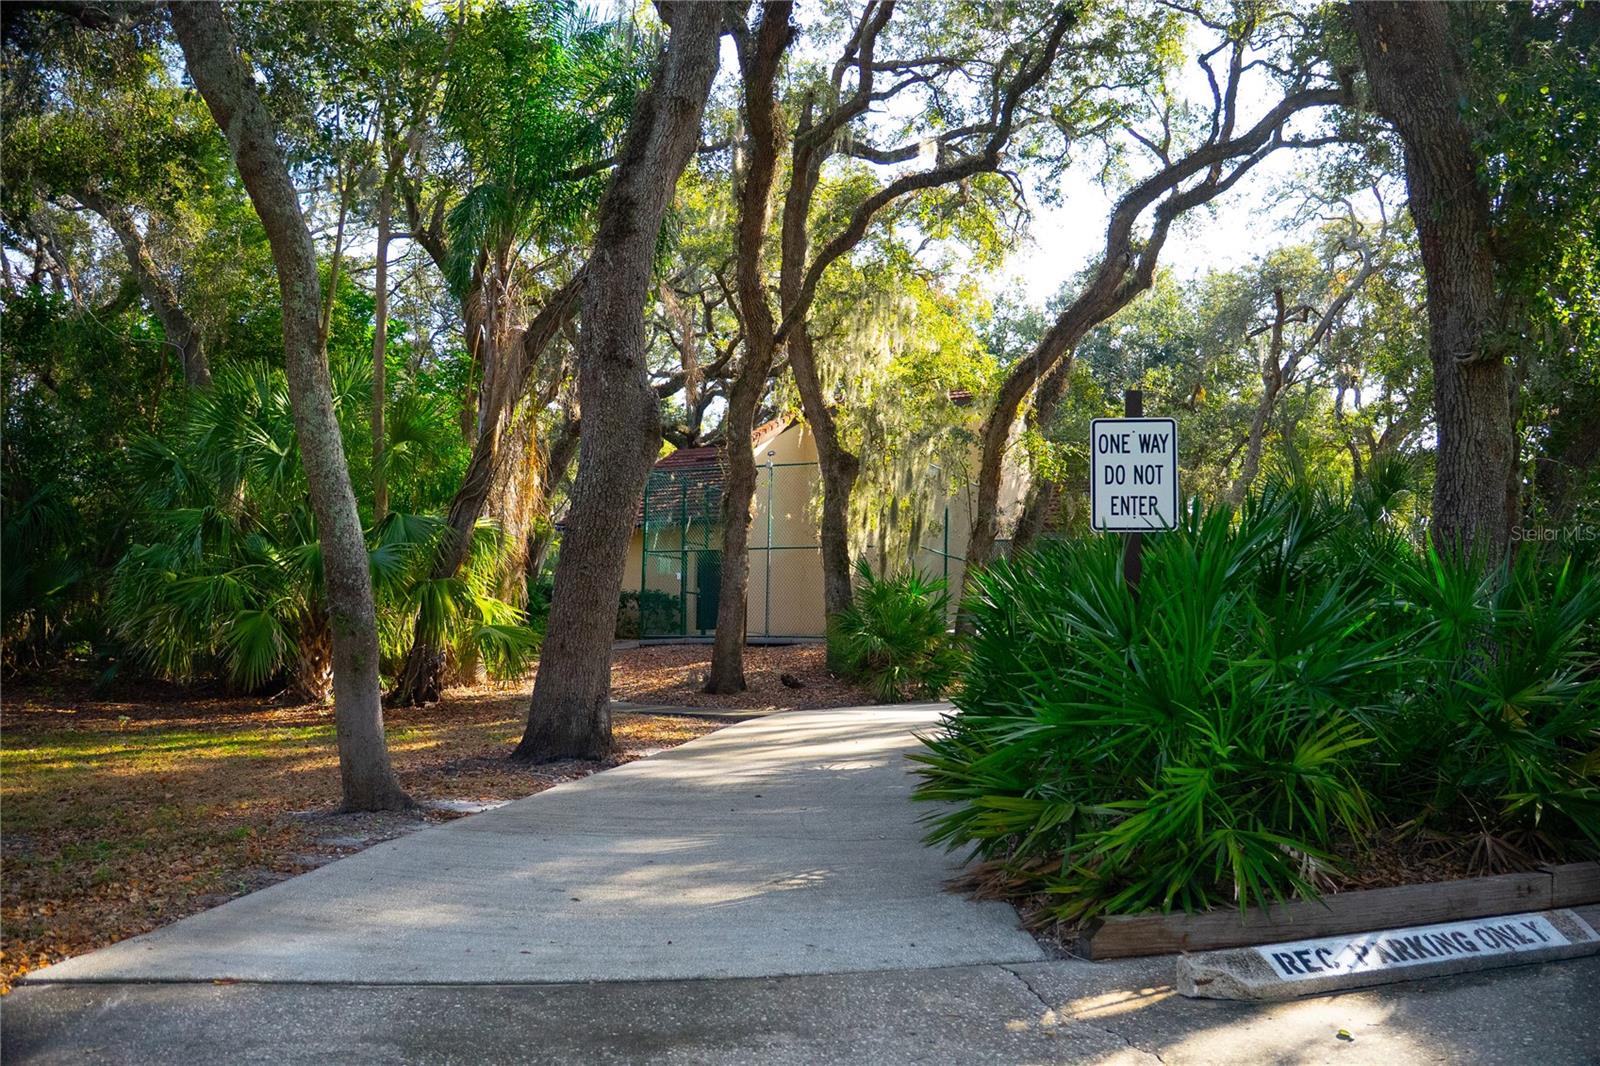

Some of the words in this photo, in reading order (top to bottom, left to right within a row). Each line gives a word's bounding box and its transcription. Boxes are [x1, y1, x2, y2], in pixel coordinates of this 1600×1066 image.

[1098, 433, 1131, 455] ONE
[1138, 433, 1169, 454] WAY
[1104, 464, 1126, 485] DO
[1133, 464, 1164, 485] NOT
[1110, 495, 1159, 516] ENTER
[1346, 931, 1480, 968] PARKING
[1473, 920, 1551, 951] ONLY
